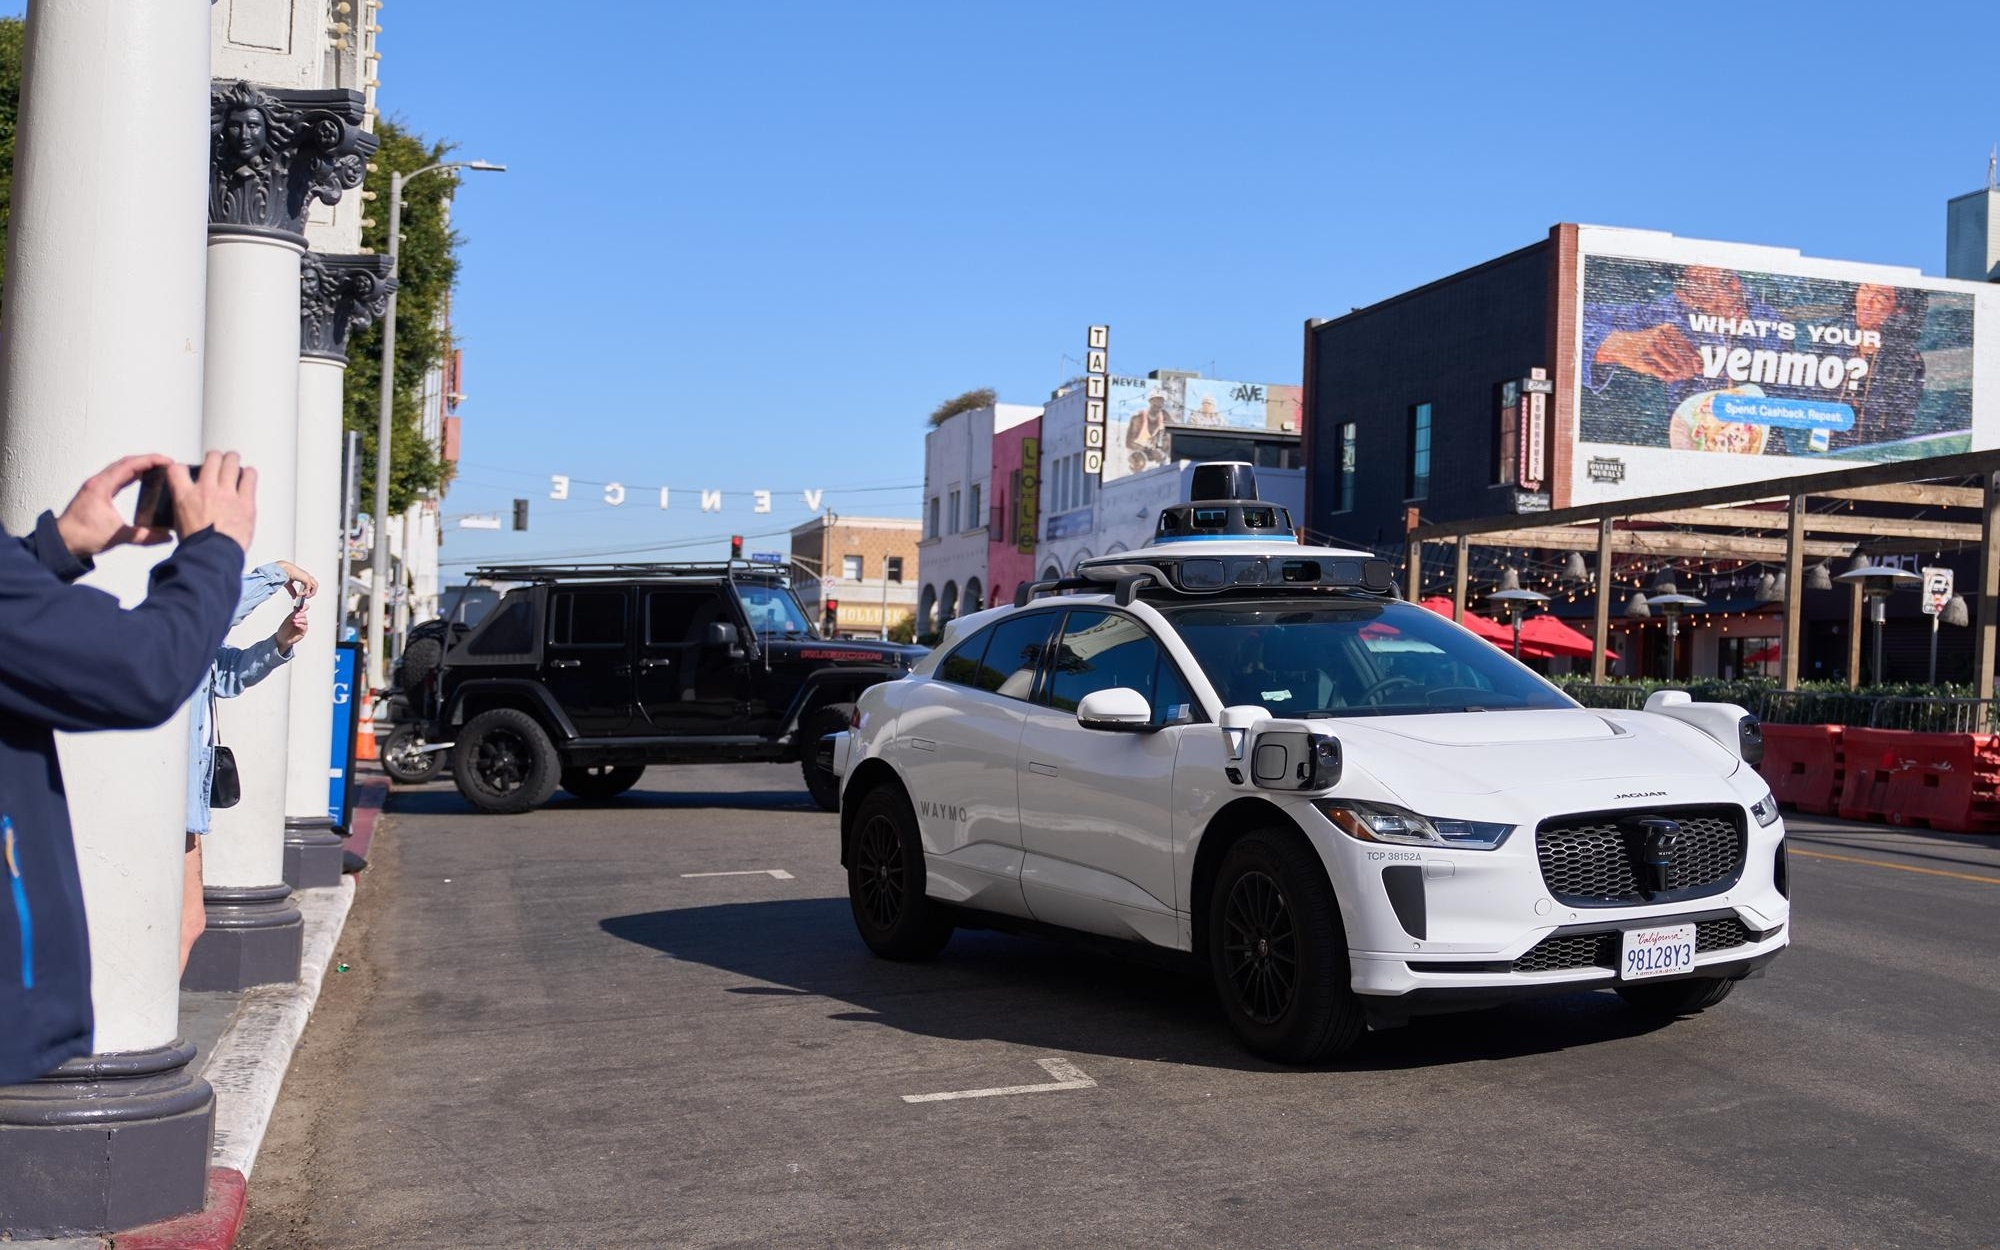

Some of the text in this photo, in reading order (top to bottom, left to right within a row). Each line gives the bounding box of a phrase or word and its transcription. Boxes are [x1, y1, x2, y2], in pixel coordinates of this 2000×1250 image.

[1689, 314, 1881, 348] WHAT'S YOUR
[1111, 377, 1146, 388] NEVER
[1088, 329, 1104, 470] TATTOO
[1725, 402, 1843, 423] Spend. Cashback. Repeat.
[1614, 791, 1668, 800] JAGUAR
[920, 801, 967, 823] WAYMO
[1367, 852, 1422, 861] TCP 38152A
[1639, 932, 1683, 946] California
[1627, 943, 1691, 972] 98128Y3
